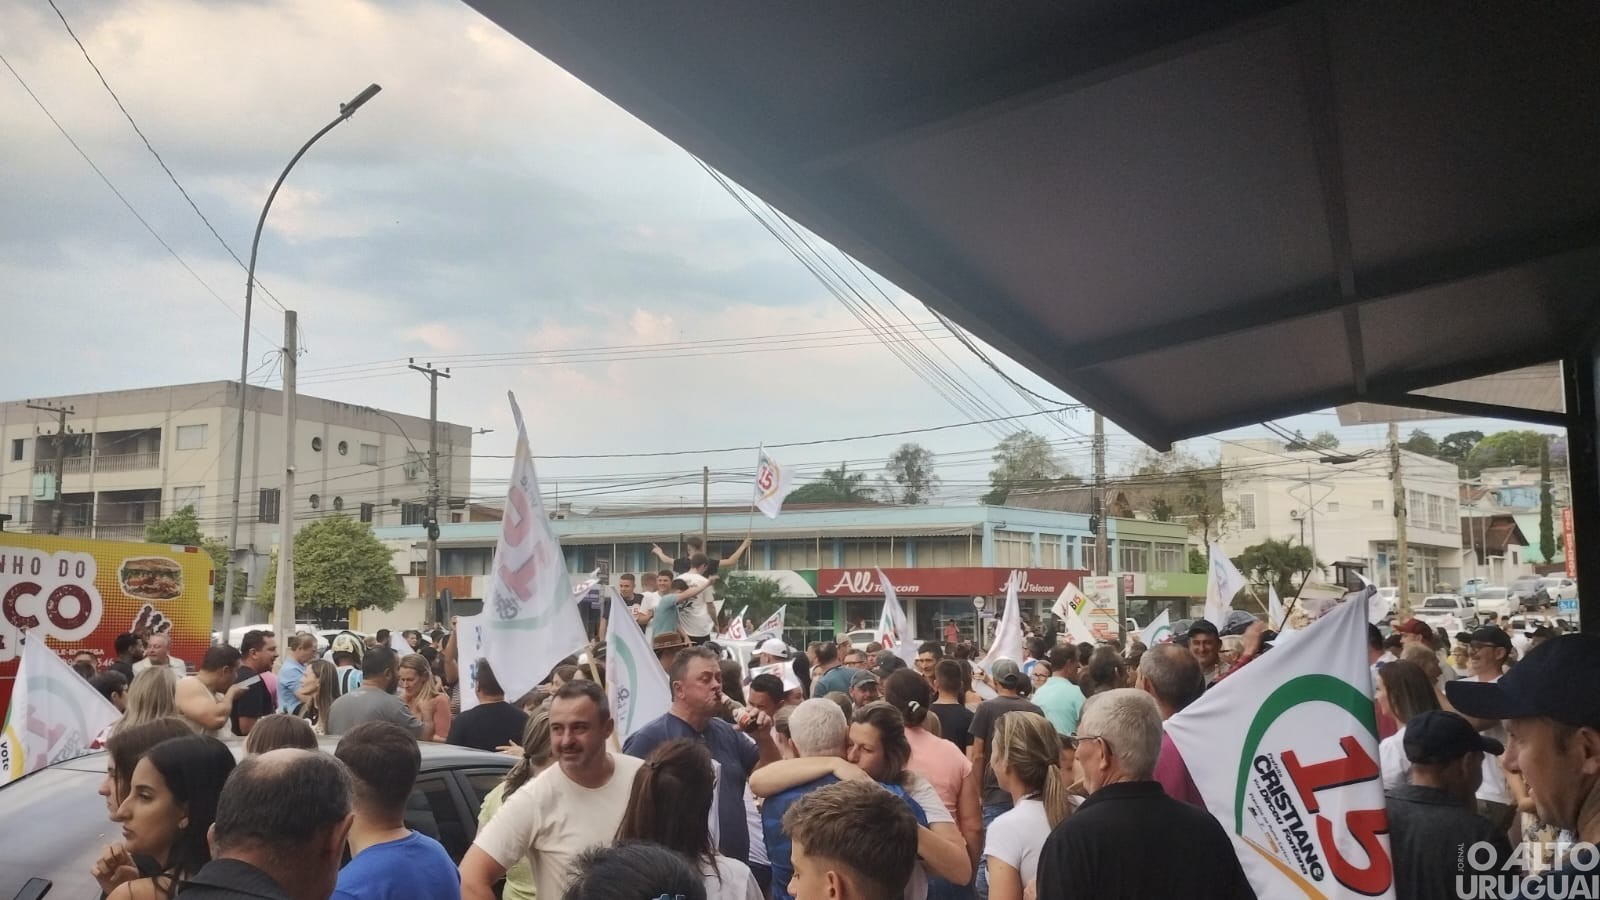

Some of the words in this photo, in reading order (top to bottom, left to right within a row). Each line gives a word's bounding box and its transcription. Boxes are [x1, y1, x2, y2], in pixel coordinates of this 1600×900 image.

[58, 559, 85, 578] DO
[826, 571, 874, 593] All
[874, 584, 919, 593] Tecom
[1029, 585, 1054, 593] Telecom
[0, 741, 9, 771] vote
[1253, 755, 1325, 882] CRISTIANO
[1281, 736, 1392, 896] 15
[1259, 789, 1283, 825] Dirceu
[1282, 827, 1308, 875] Fontana
